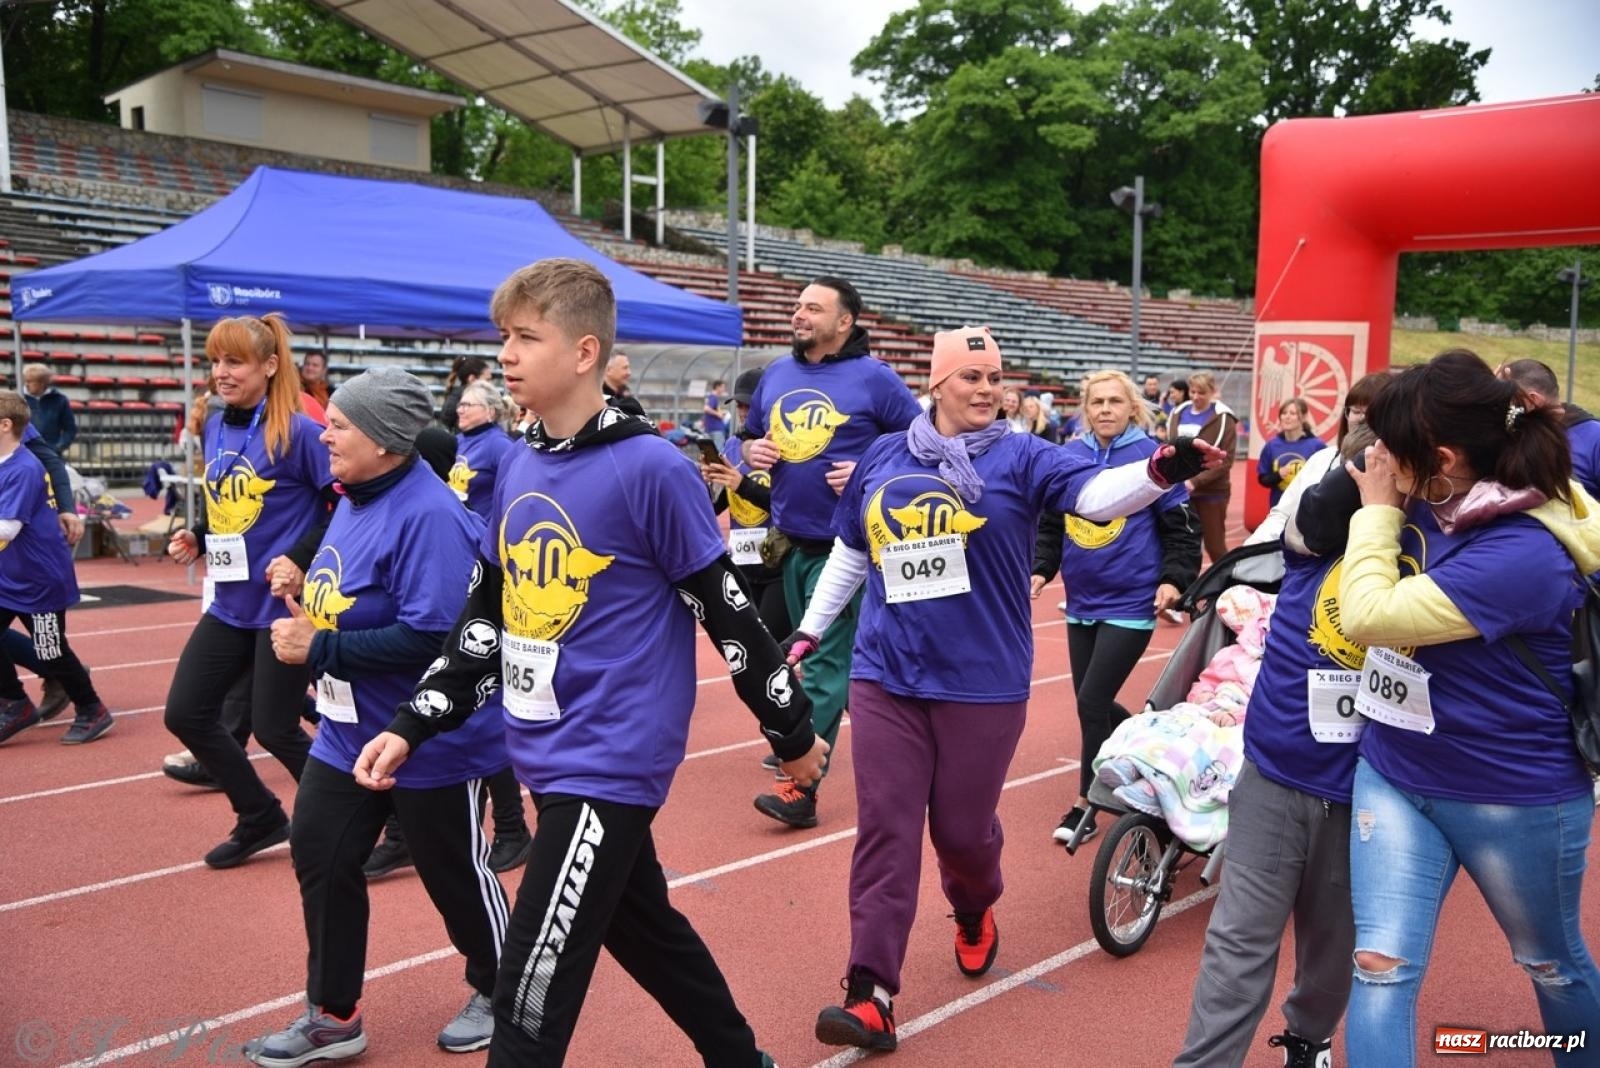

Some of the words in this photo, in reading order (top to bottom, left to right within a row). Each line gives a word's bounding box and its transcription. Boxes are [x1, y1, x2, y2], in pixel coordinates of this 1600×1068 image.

[916, 502, 953, 539] 10
[207, 550, 232, 566] 053
[532, 536, 568, 586] 10
[901, 556, 946, 581] 049
[33, 633, 61, 648] LOST
[522, 643, 551, 656] BARIER
[505, 661, 534, 693] 085
[1329, 674, 1353, 683] BIEG
[1369, 669, 1409, 705] 089
